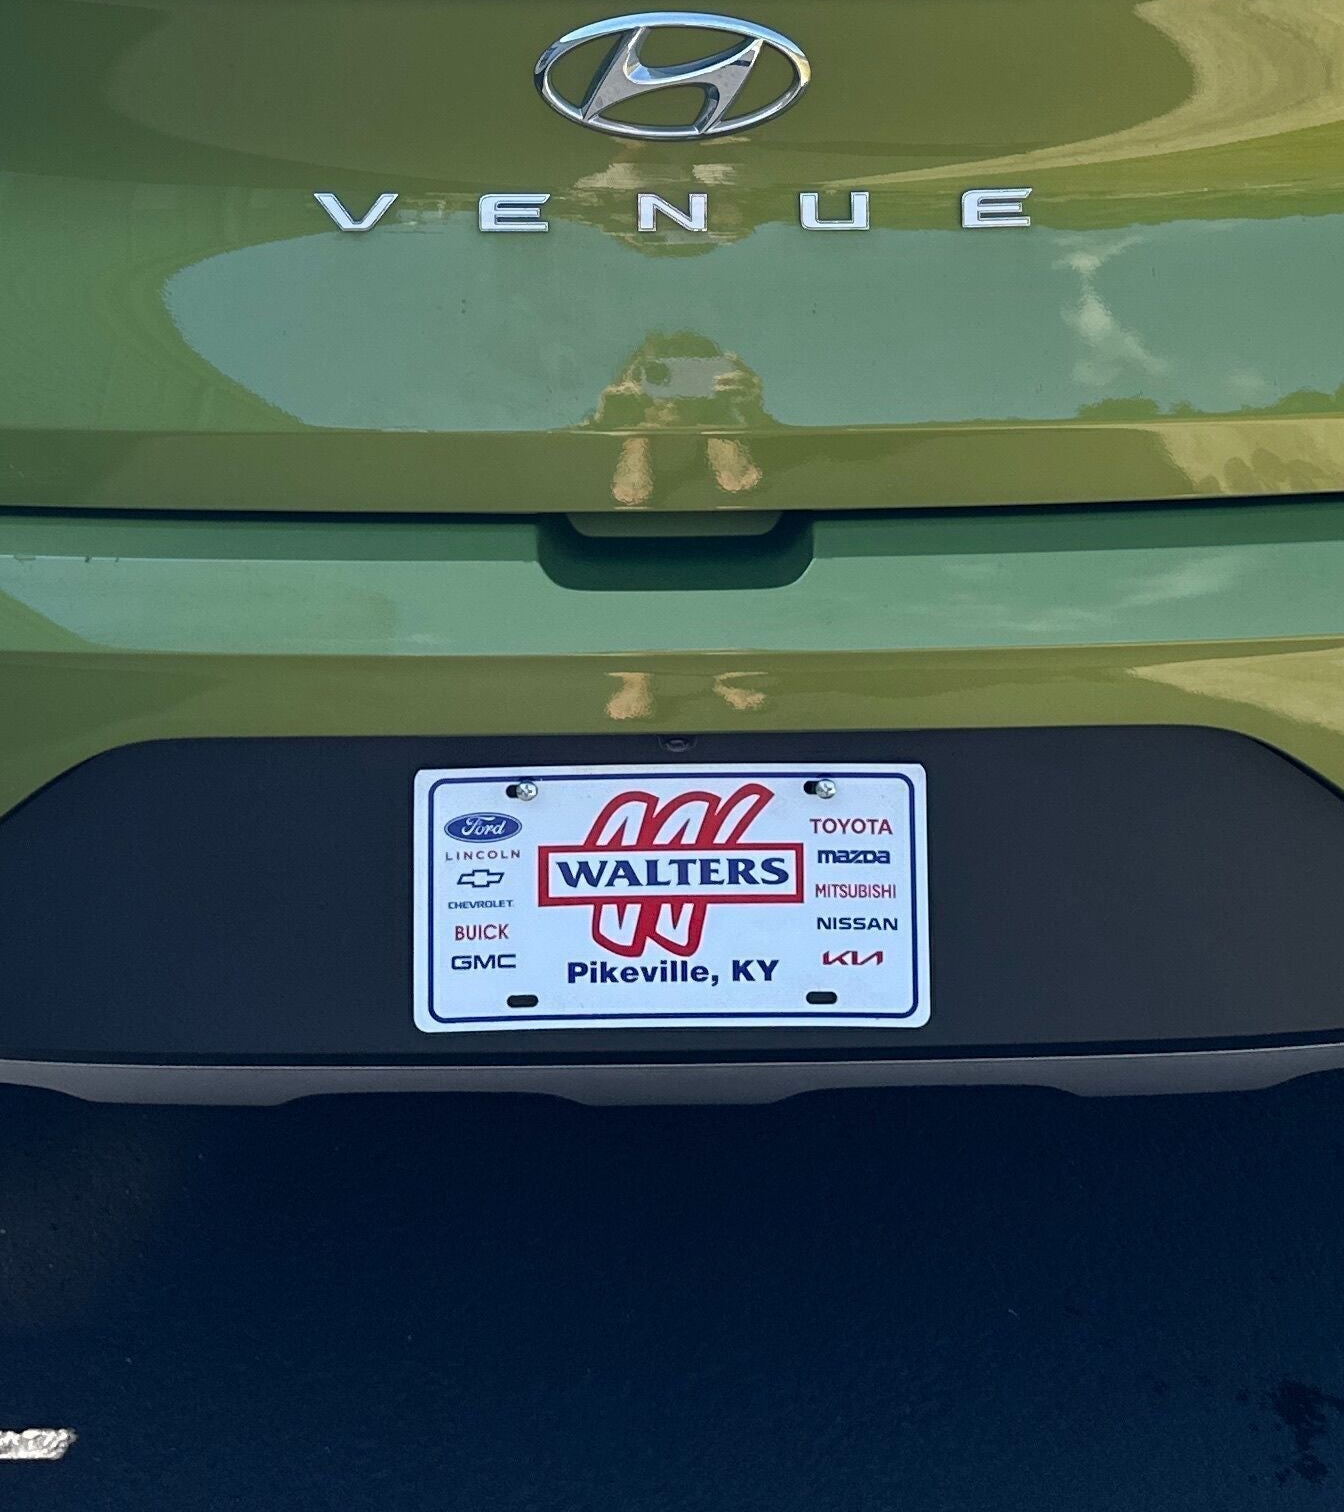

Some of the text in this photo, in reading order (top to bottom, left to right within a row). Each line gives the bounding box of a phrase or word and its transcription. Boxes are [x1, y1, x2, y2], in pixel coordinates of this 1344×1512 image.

[313, 188, 1033, 232] VENUE
[461, 816, 507, 836] Ford
[809, 818, 893, 835] TOYOTA
[445, 849, 521, 861] LINCOLN
[556, 857, 790, 888] WALTERS
[815, 884, 897, 899] MITSUBISHI
[448, 899, 514, 910] CHEVROLET
[816, 917, 898, 930] NISSAN
[454, 924, 510, 941] BUICK
[451, 954, 517, 970] GMC
[822, 950, 884, 966] KIA
[567, 959, 780, 987] Pikeville, KY
